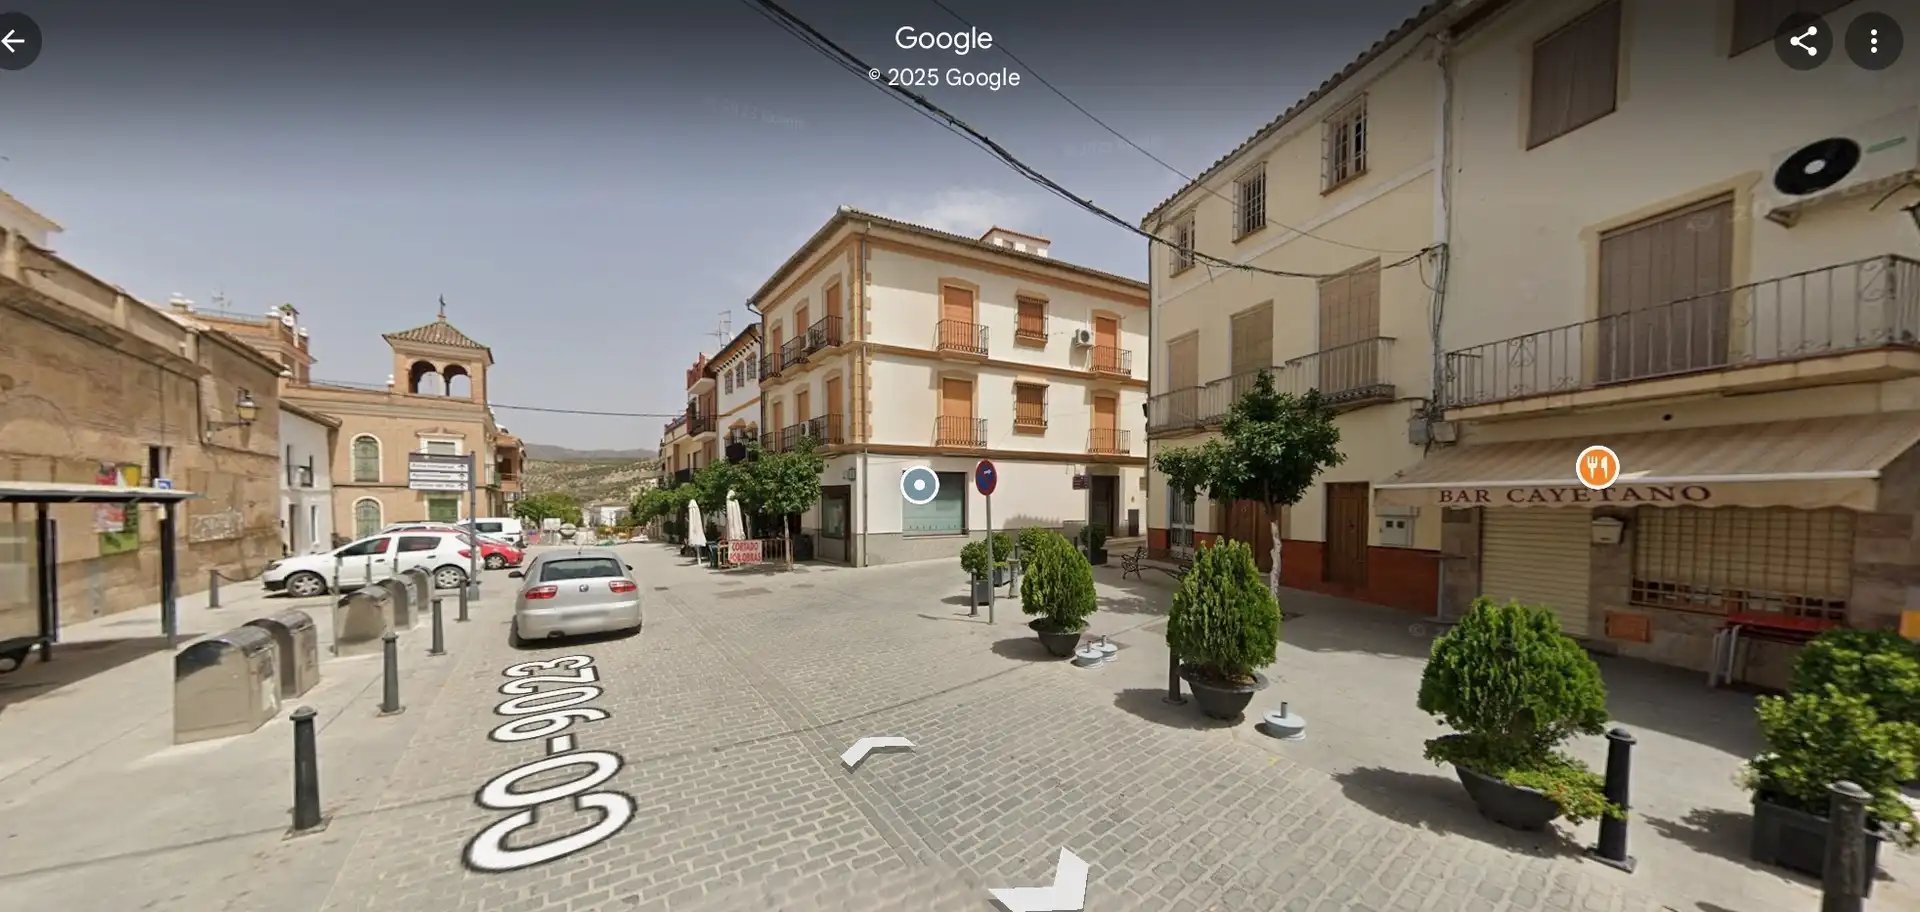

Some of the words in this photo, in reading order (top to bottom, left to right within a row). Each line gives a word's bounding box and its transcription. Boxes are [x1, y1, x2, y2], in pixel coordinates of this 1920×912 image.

[1440, 488, 1491, 503] BAR
[1507, 485, 1712, 503] CAYETANO
[731, 542, 758, 551] CORTADO
